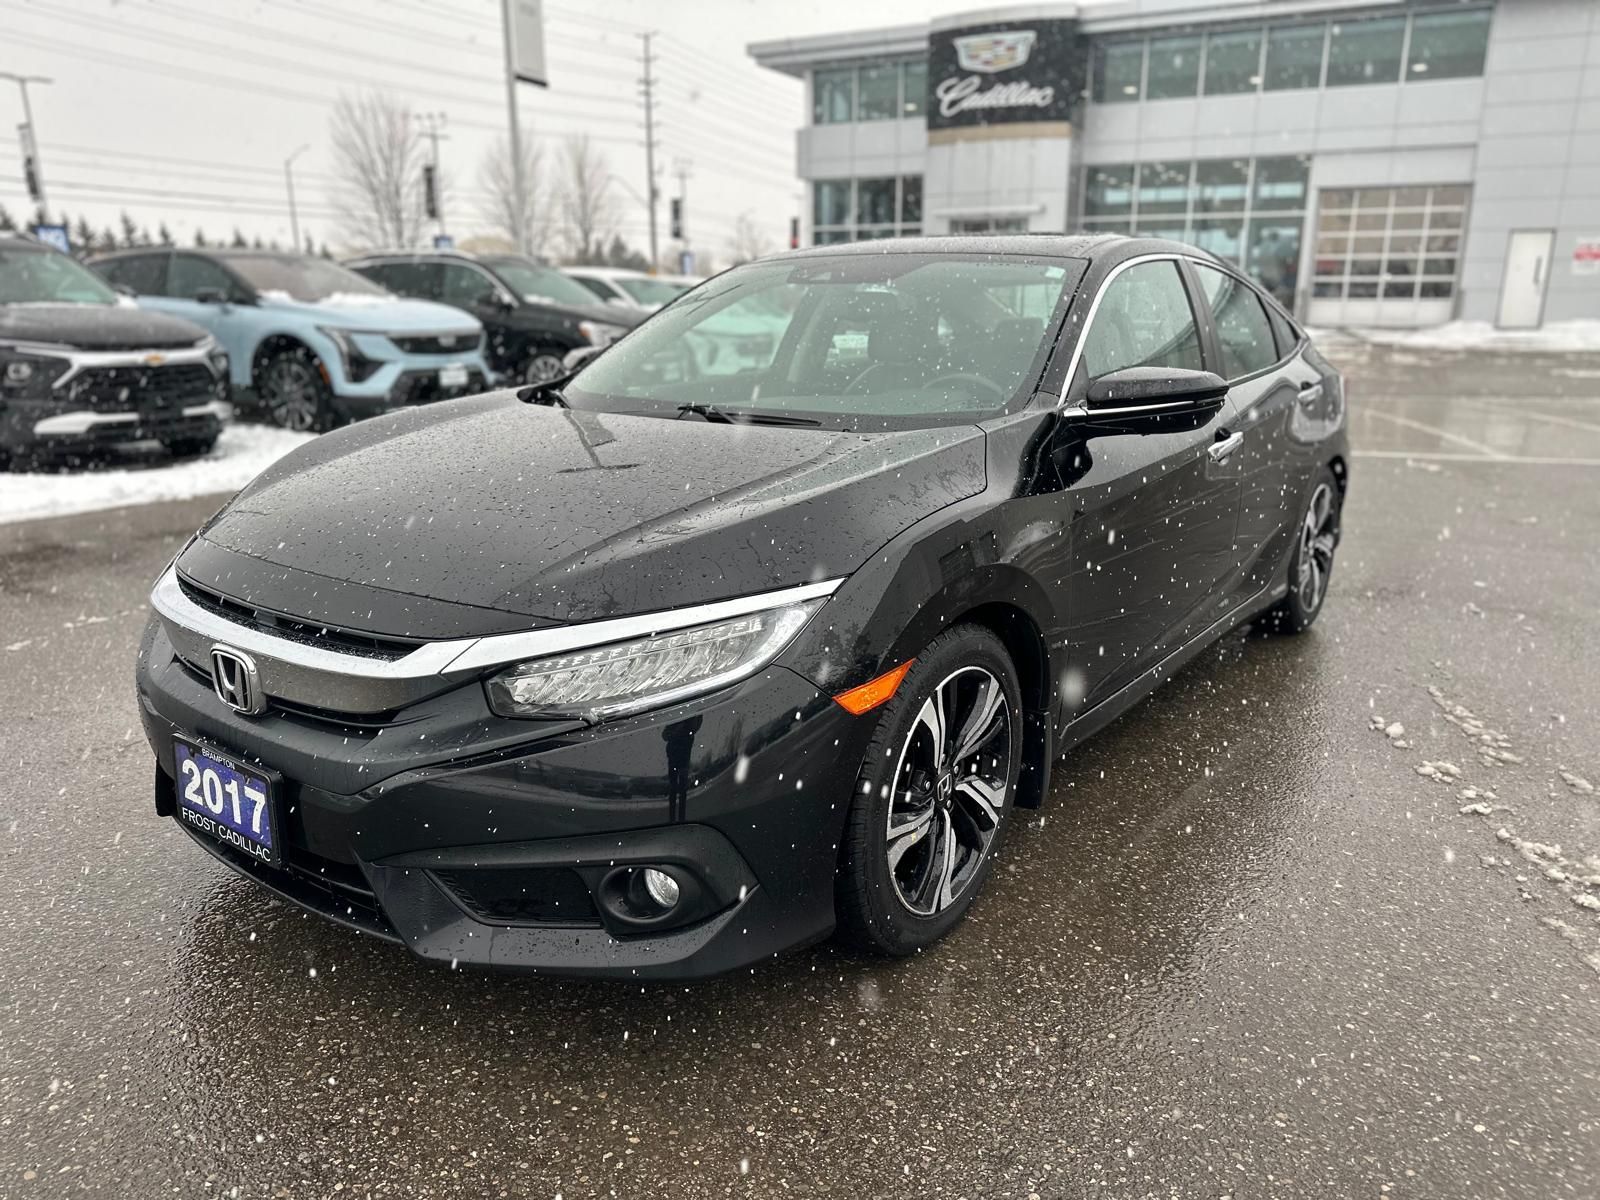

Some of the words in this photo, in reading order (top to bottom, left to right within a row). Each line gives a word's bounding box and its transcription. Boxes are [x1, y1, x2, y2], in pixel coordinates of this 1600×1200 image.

[936, 75, 1054, 117] Cadillac
[201, 747, 236, 770] BRAMPTON
[182, 759, 266, 834] 2017
[182, 806, 216, 833] FROST
[218, 825, 271, 862] CADILLAC
